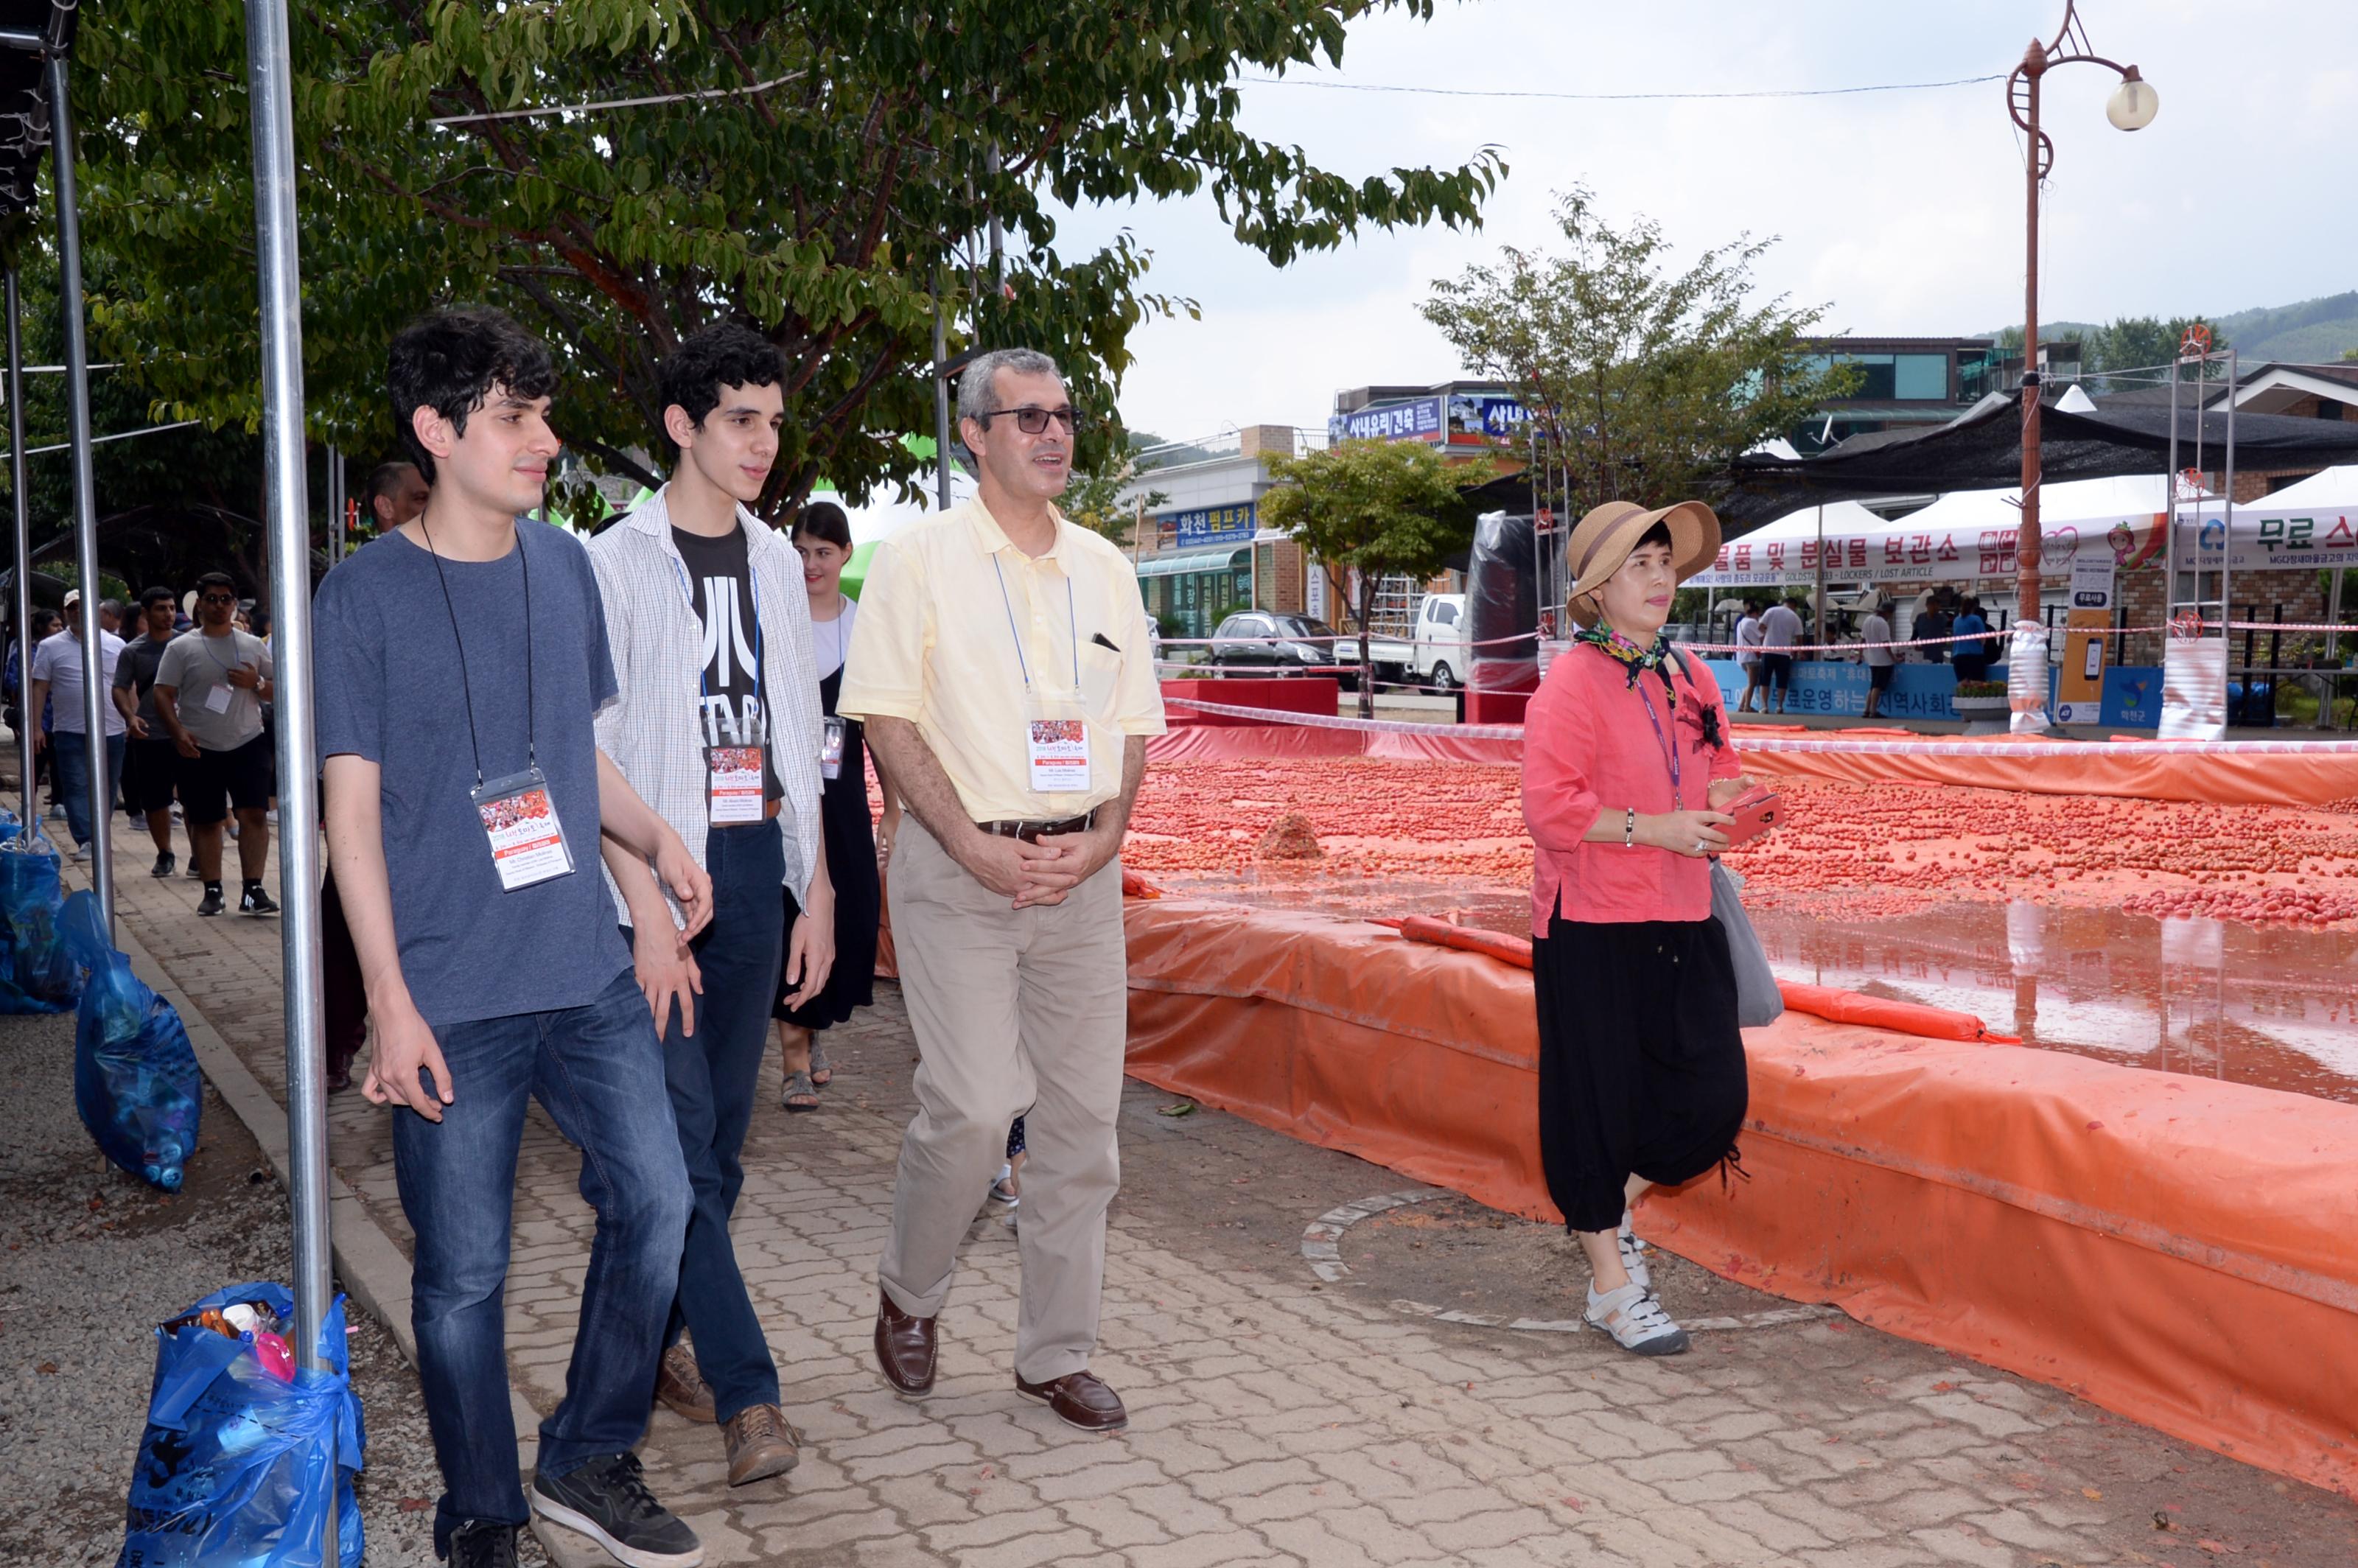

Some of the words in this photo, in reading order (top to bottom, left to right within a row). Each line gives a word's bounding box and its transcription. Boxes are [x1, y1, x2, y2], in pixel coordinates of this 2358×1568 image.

[2257, 517, 2314, 552] 무료
[2325, 515, 2358, 550] 스
[1768, 542, 1785, 571] 및
[1800, 538, 1867, 570] 분실물
[1885, 533, 1959, 564] 보관소
[1785, 570, 1833, 582] GOLDSTA333
[1840, 569, 1872, 580] LOCKERS
[1881, 568, 1899, 579] LOST
[1900, 567, 1934, 578] ARTICLE
[2121, 709, 2147, 722] 화천군
